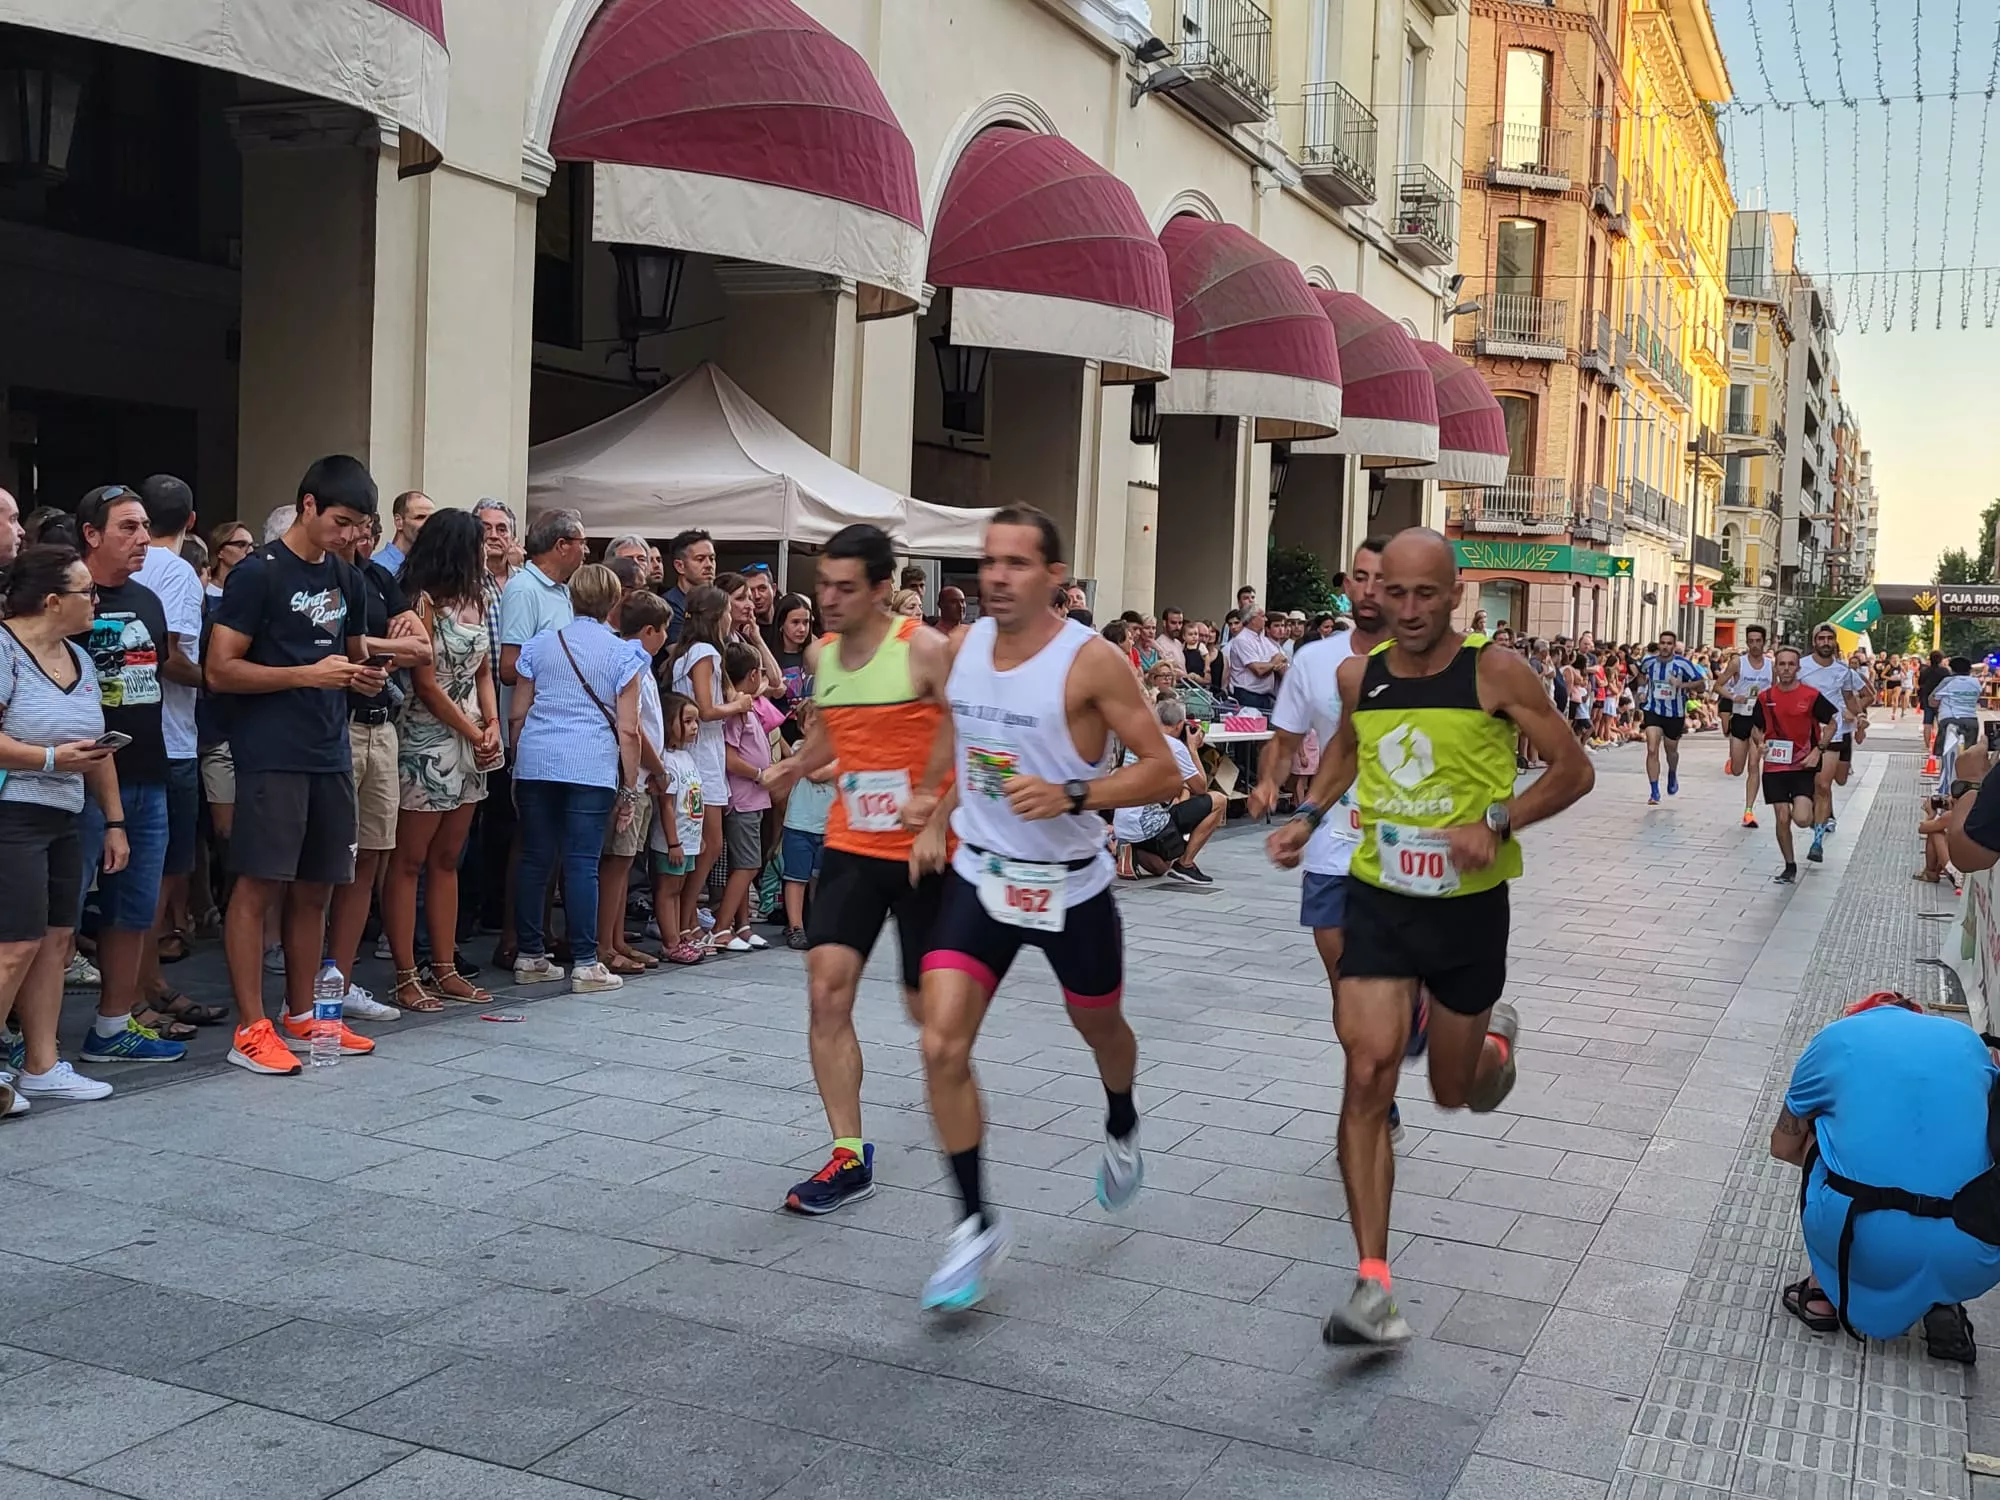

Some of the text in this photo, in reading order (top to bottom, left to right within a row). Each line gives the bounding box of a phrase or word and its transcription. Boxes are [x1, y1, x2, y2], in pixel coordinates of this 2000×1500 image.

[1942, 593, 2000, 604] CAJA RUR
[1965, 604, 2000, 613] ARAGÓ
[1400, 849, 1444, 878] 070
